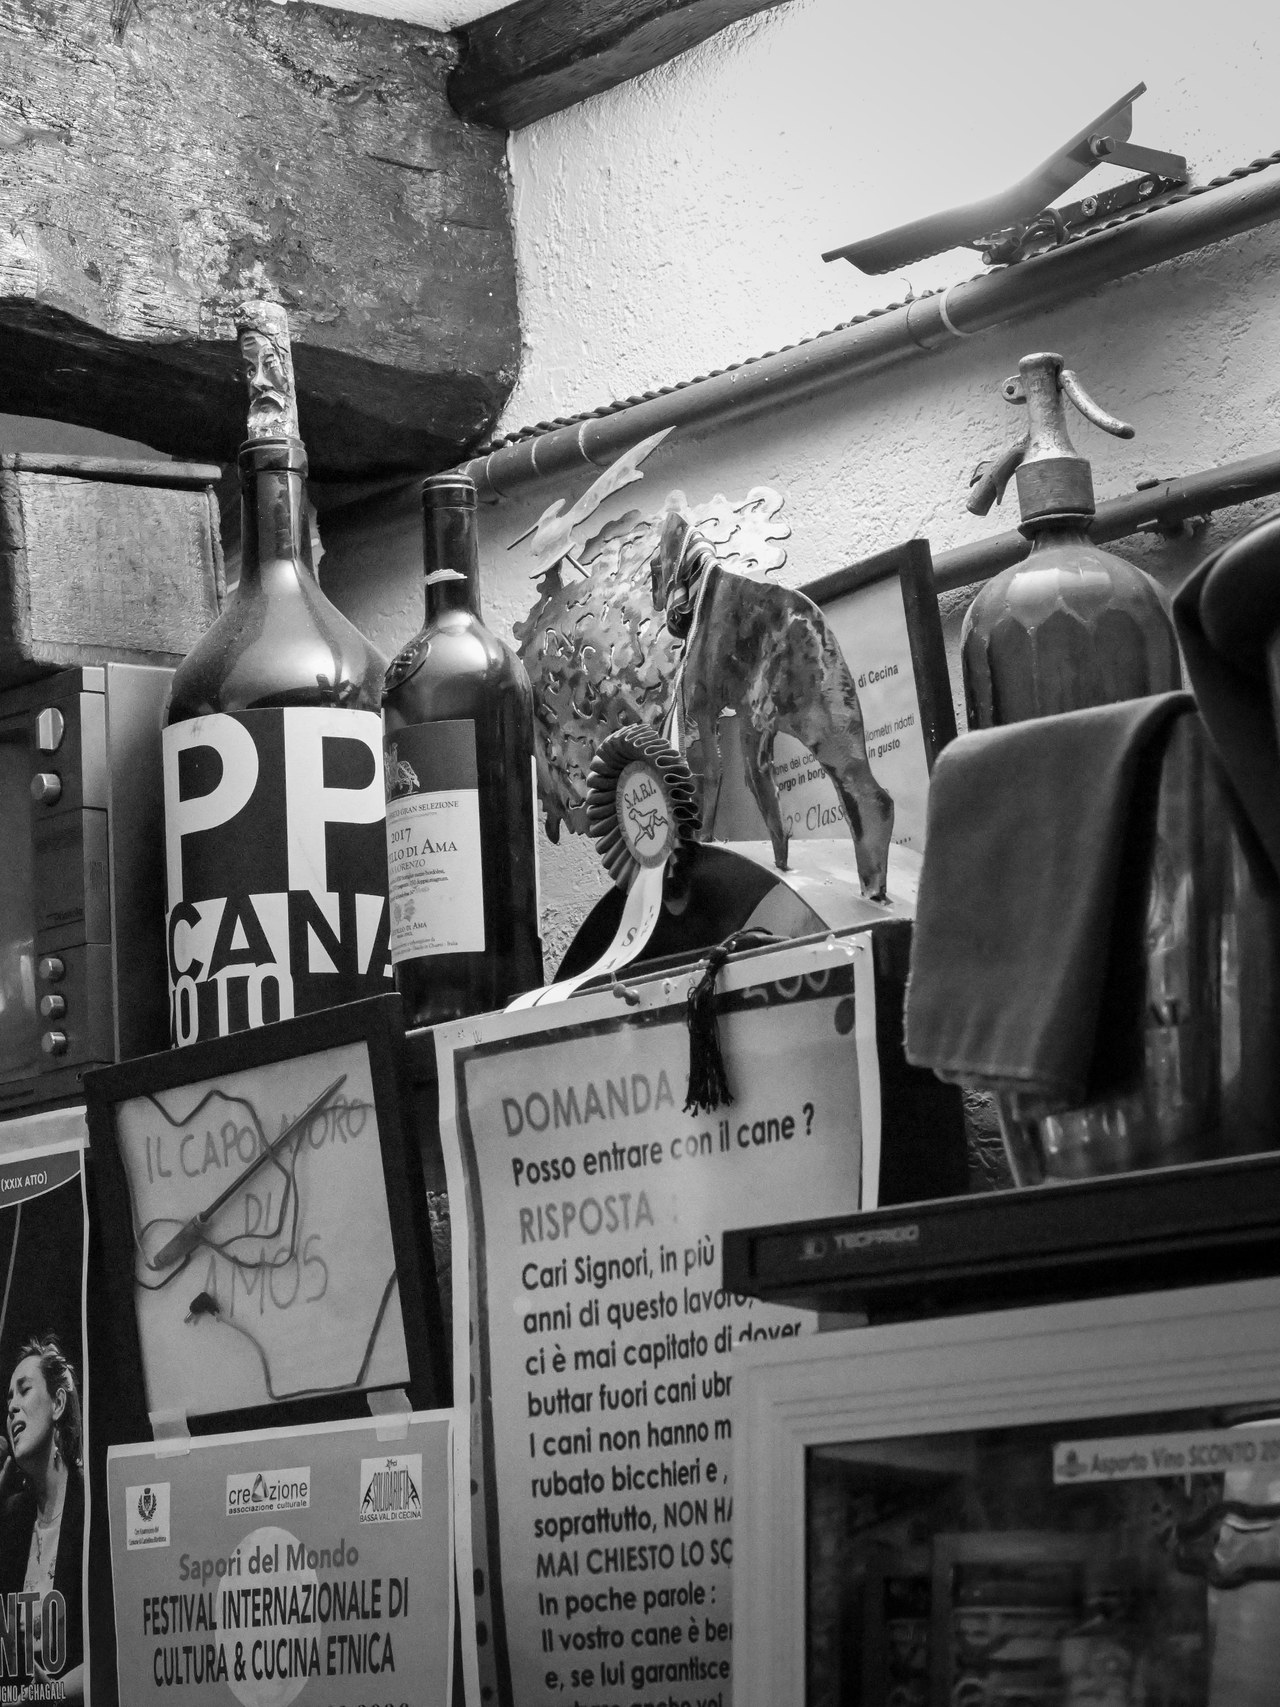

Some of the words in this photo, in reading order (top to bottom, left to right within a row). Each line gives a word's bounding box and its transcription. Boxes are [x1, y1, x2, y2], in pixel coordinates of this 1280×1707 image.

[858, 675, 867, 689] di
[868, 664, 899, 685] Cecina
[868, 745, 876, 759] in
[877, 738, 901, 759] gusto
[798, 771, 806, 785] in
[418, 801, 459, 811] SELEZIONE
[391, 827, 411, 843] 2017
[406, 845, 418, 857] DI
[502, 1069, 675, 1138] DOMANDA
[144, 1136, 172, 1184] IL
[512, 1155, 576, 1187] Posso
[584, 1140, 663, 1176] entrare
[670, 1131, 712, 1161] con
[719, 1118, 730, 1152] il
[737, 1112, 795, 1150] cane
[0, 1176, 23, 1192] (XXIX
[24, 1170, 48, 1187] ATTO)
[244, 1192, 272, 1236] DI
[519, 1190, 655, 1245] RISPOSTA
[521, 1258, 568, 1290] Cari
[574, 1247, 653, 1288] Signori,
[660, 1245, 677, 1274] in
[684, 1234, 715, 1277] più
[523, 1302, 571, 1334] anni
[579, 1299, 599, 1328] di
[607, 1290, 678, 1331] questo
[525, 1347, 545, 1376] ci
[552, 1344, 567, 1373] è
[574, 1339, 616, 1371] mai
[623, 1330, 708, 1369] capitato
[714, 1324, 732, 1353] di
[528, 1386, 592, 1418] buttar
[600, 1380, 647, 1411] fuori
[654, 1374, 696, 1405] cani
[530, 1432, 536, 1458] I
[543, 1426, 592, 1457] cani
[599, 1429, 640, 1452] non
[647, 1421, 709, 1448] hanno
[531, 1468, 605, 1498] rubato
[612, 1457, 700, 1491] bicchieri
[706, 1462, 718, 1482] e
[228, 1503, 273, 1514] associazione
[277, 1500, 307, 1510] culturale
[360, 1513, 378, 1522] BASSA
[379, 1512, 390, 1521] VAL
[391, 1512, 397, 1520] DI
[398, 1510, 421, 1519] CECINA
[534, 1504, 657, 1543] soprattutto,
[664, 1499, 708, 1528] NON
[179, 1553, 242, 1586] Sapori
[248, 1544, 279, 1575] del
[286, 1538, 359, 1571] Mondo
[536, 1551, 579, 1579] MAI
[586, 1544, 675, 1575] CHIESTO
[681, 1541, 705, 1567] LO
[143, 1592, 217, 1636] FESTIVAL
[223, 1579, 381, 1629] INTERNAZIONALE
[388, 1577, 409, 1618] DI
[538, 1592, 559, 1616] In
[565, 1586, 637, 1621] poche
[644, 1580, 706, 1615] parole
[542, 1628, 554, 1653] Il
[559, 1625, 624, 1650] vostro
[631, 1625, 682, 1647] cane
[688, 1616, 700, 1643] è
[153, 1643, 228, 1687] CULTURA
[234, 1641, 247, 1681] &
[251, 1637, 320, 1680] CUCINA
[326, 1631, 396, 1675] ETNICA
[545, 1670, 565, 1692] e,
[571, 1669, 595, 1688] se
[601, 1661, 625, 1687] lui
[631, 1655, 730, 1690] garantisce
[21, 1684, 26, 1701] E
[28, 1680, 67, 1701] CHAGALL
